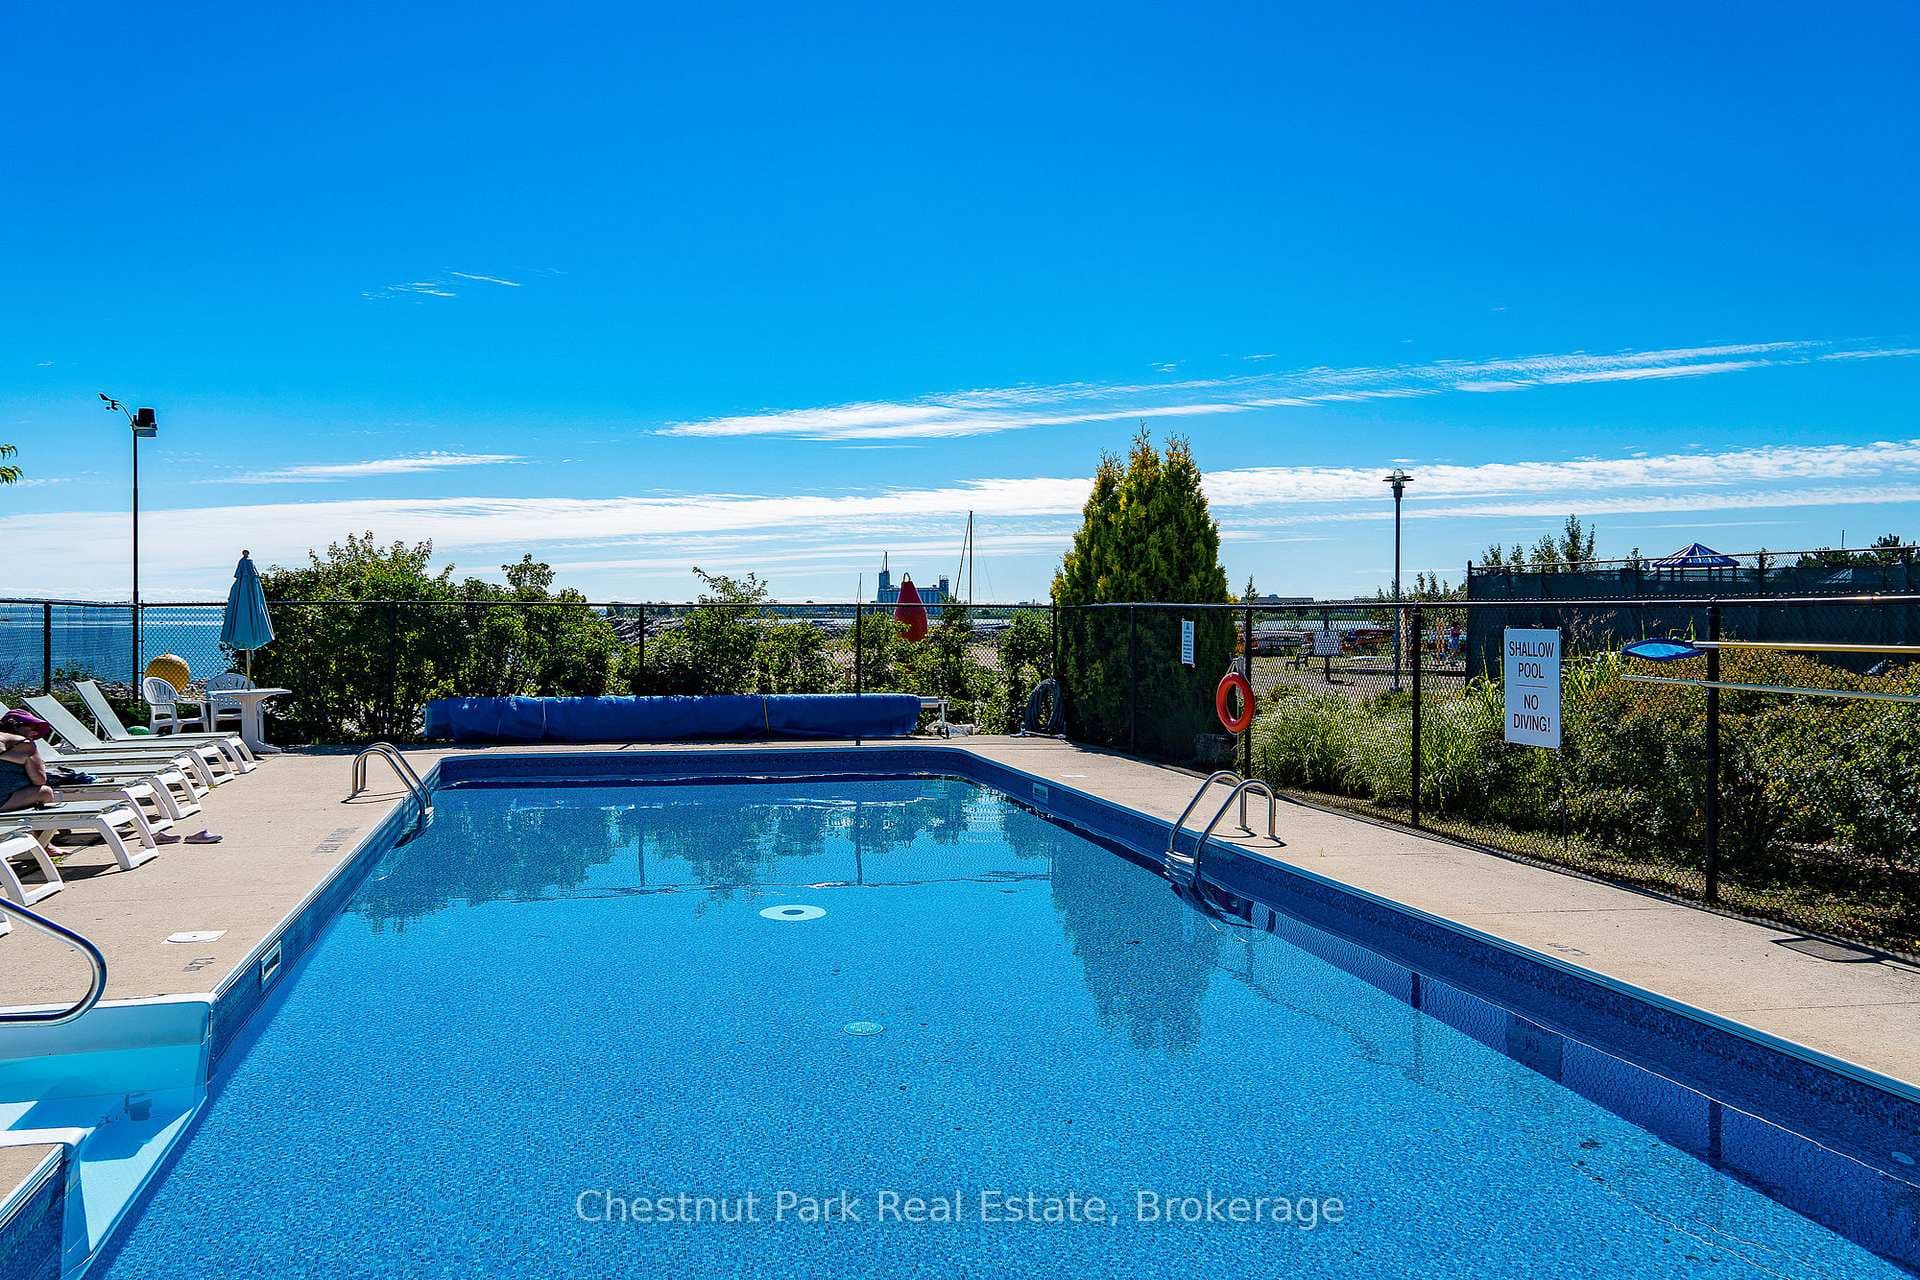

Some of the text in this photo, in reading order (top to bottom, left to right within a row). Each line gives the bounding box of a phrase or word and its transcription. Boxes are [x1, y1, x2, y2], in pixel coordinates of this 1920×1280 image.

[1509, 641, 1554, 657] SHALLOW
[1518, 662, 1544, 679] POOL
[1524, 694, 1539, 710] NO
[1513, 713, 1551, 732] DIVING!
